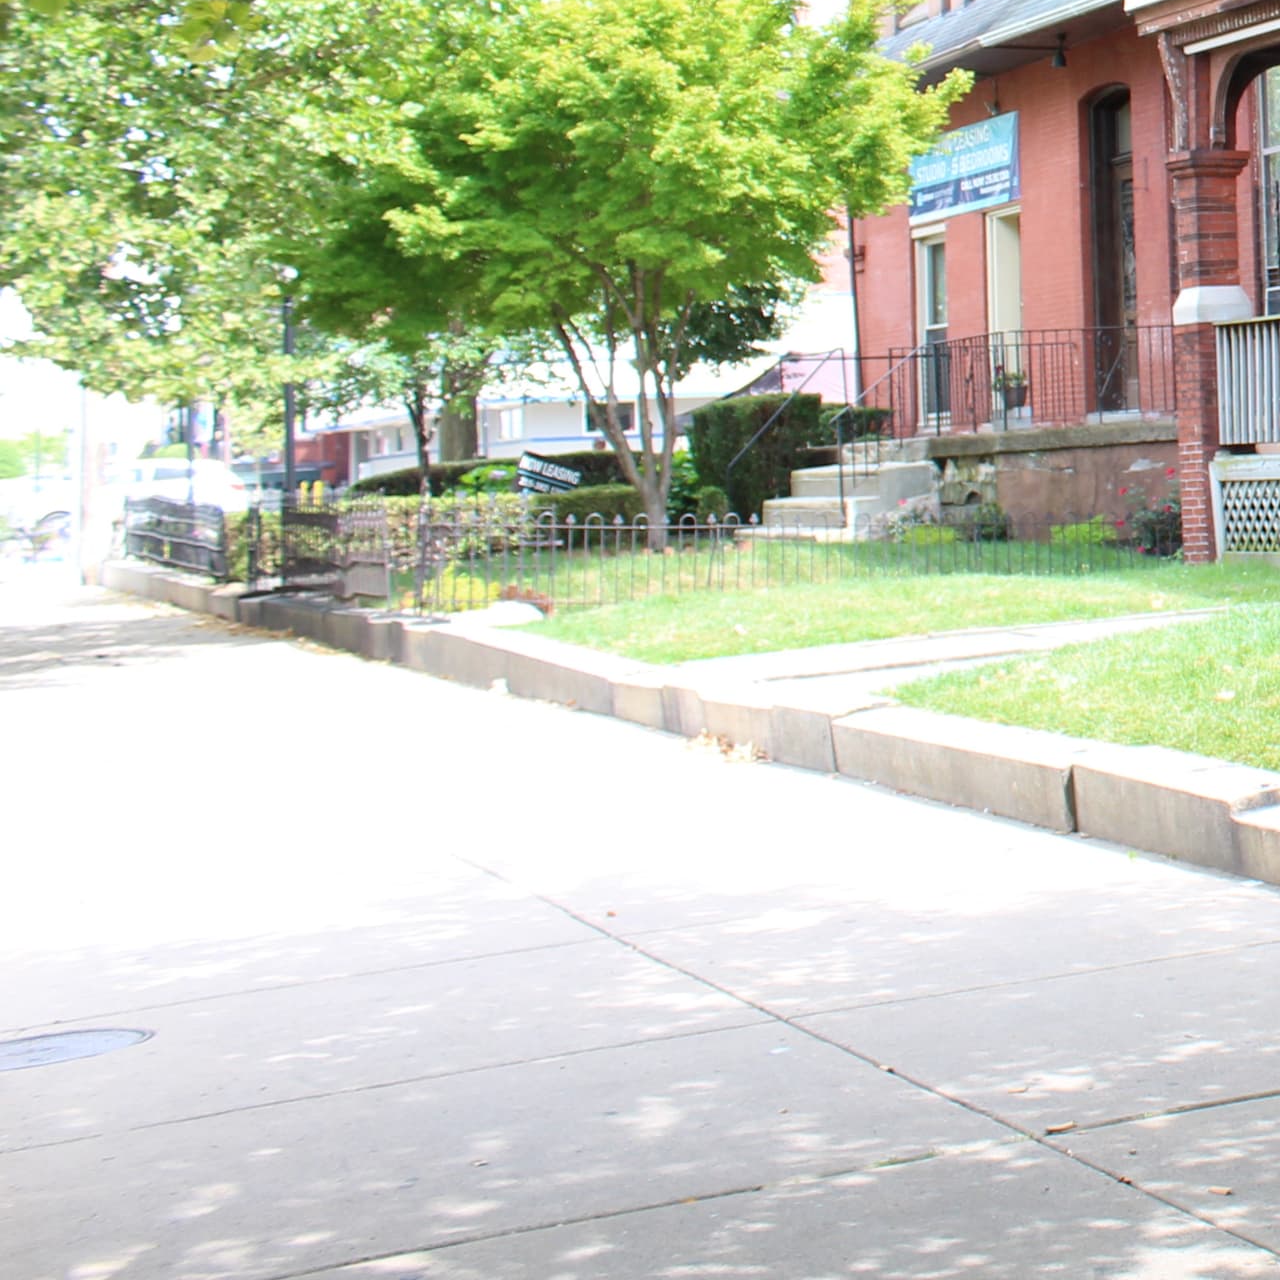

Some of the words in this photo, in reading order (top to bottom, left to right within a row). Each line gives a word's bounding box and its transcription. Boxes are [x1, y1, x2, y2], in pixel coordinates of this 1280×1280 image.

[916, 161, 946, 183] STUDIO
[959, 143, 1009, 173] BEDROOMS
[542, 462, 580, 485] LEASING
